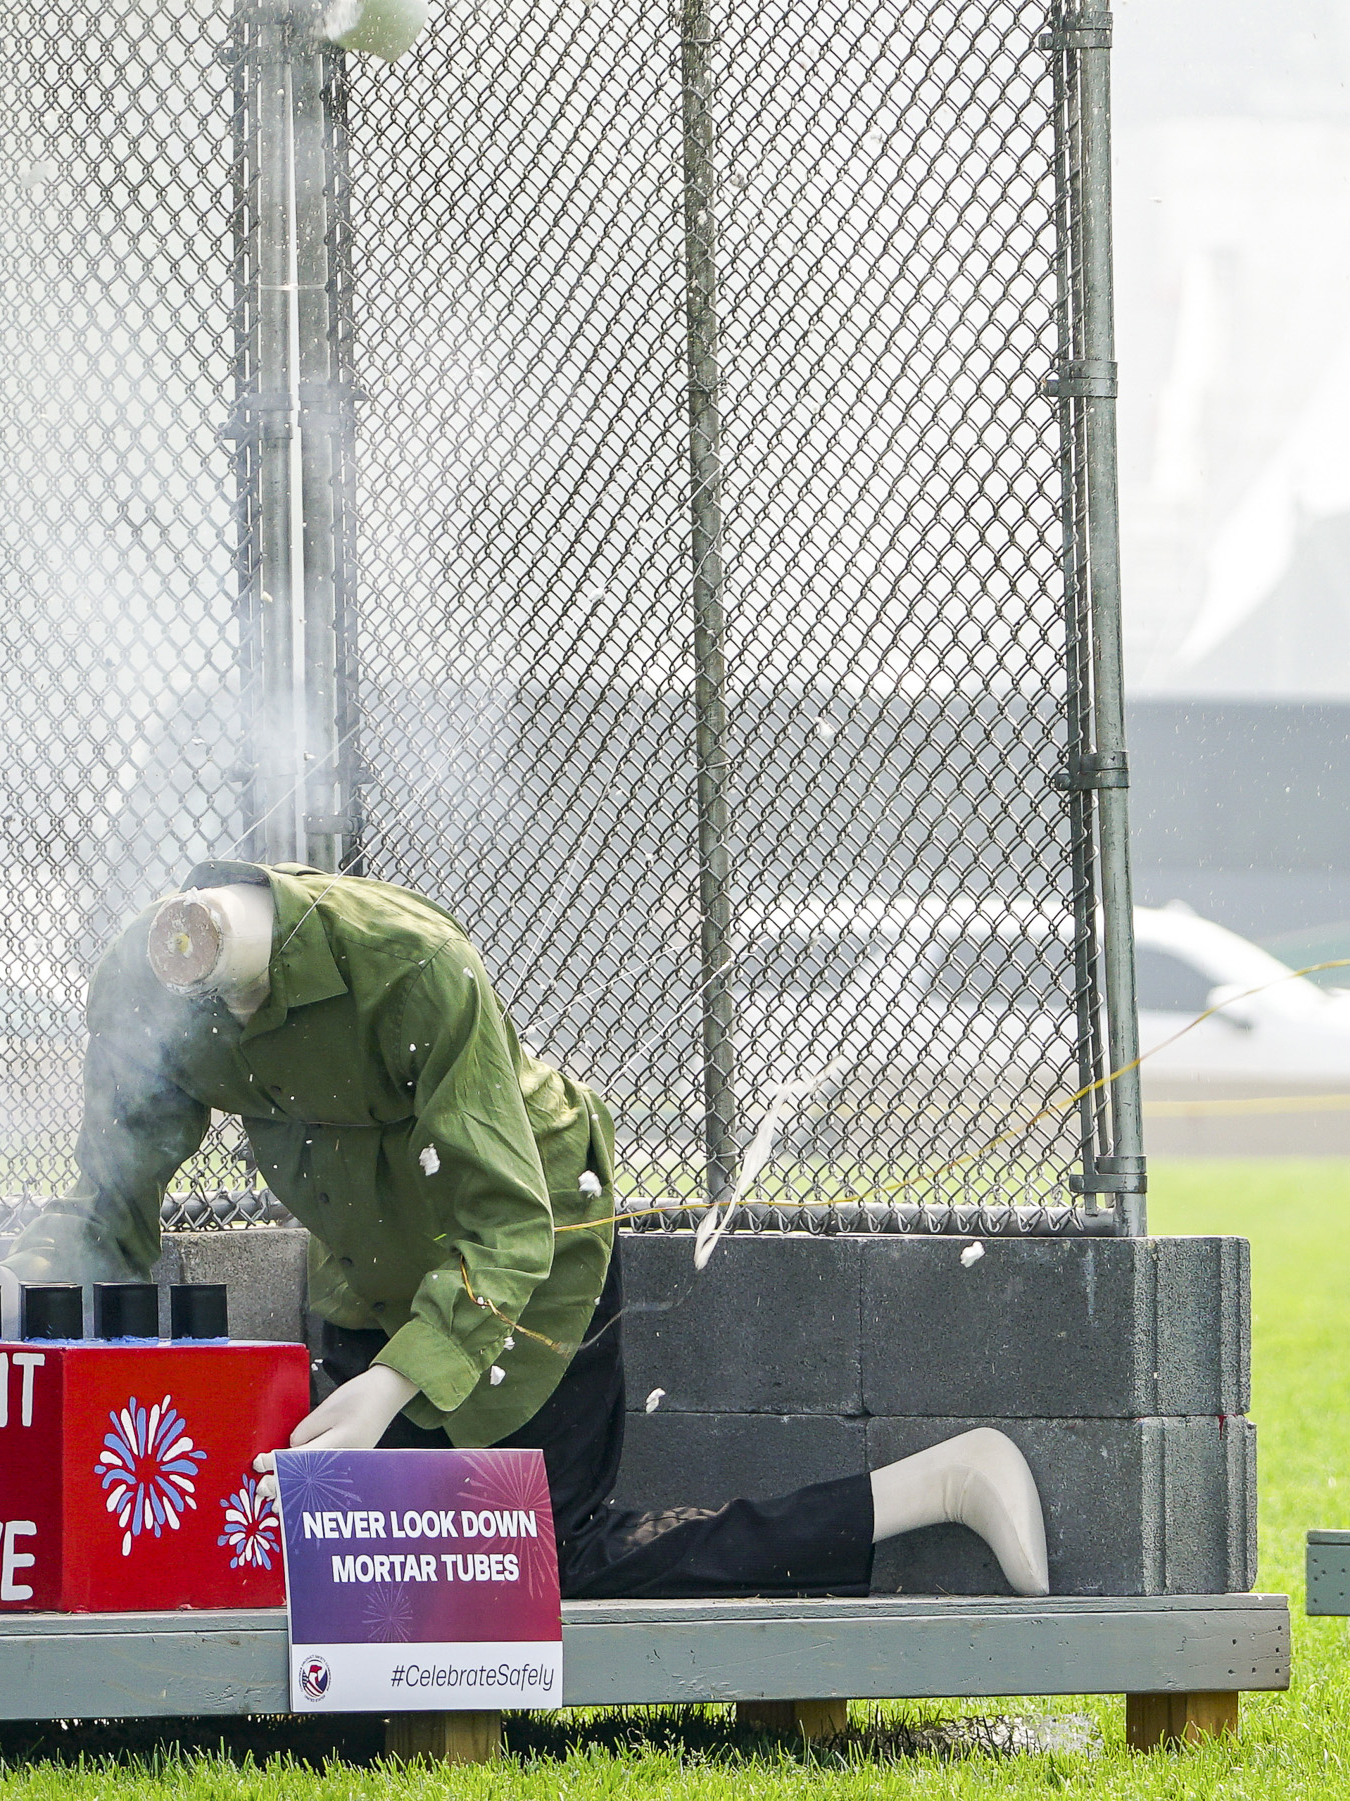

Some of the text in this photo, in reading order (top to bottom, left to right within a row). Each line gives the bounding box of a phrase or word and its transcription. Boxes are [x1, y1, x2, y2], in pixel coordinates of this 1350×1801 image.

[302, 1510, 538, 1539] NEVER LOOK DOWN
[331, 1553, 520, 1583] MORTAR TUBES
[390, 1663, 555, 1692] #CelebrateSafely
